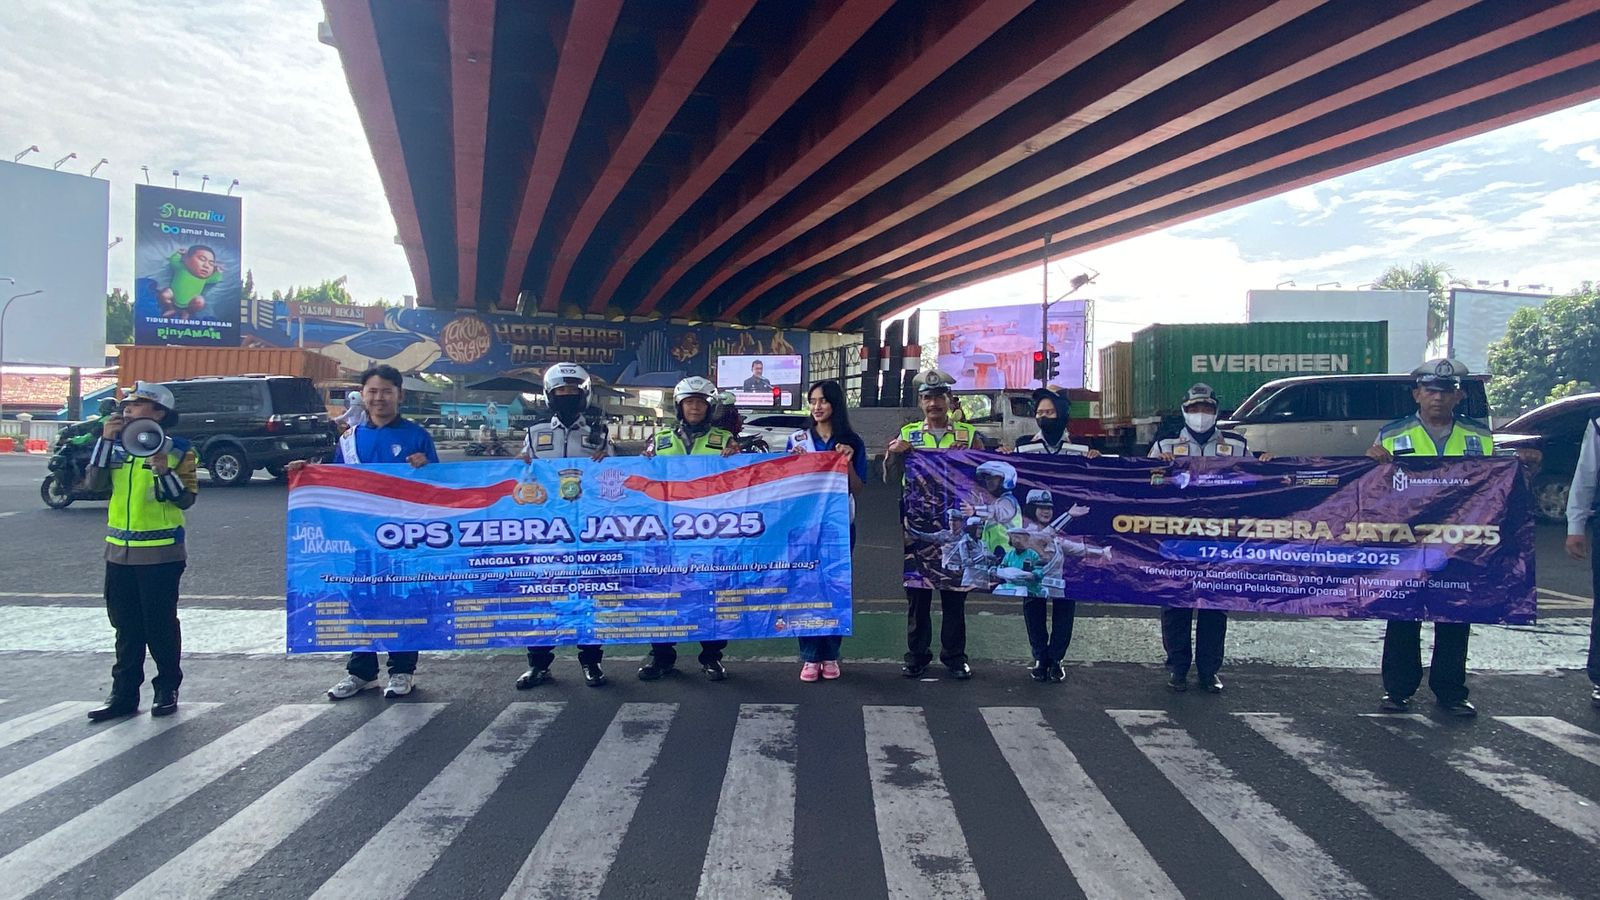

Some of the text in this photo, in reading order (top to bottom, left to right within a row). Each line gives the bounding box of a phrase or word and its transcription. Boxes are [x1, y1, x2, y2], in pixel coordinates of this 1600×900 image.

[177, 207, 225, 222] tunaiku
[181, 228, 203, 236] amar
[204, 229, 226, 238] bank
[299, 304, 364, 319] STASIUN BEKASI
[145, 316, 169, 324] TIDUR
[202, 319, 232, 327] DENGAN
[1191, 353, 1348, 373] EVERGREEN
[292, 526, 324, 540] JAGA
[376, 512, 763, 547] OPS ZEBRA JAYA 2025
[1112, 514, 1501, 546] OPERASI ZEBRA JAYA 2025
[469, 557, 516, 567] TANGGAL
[519, 556, 529, 565] 17
[533, 555, 554, 564] NOV
[563, 554, 574, 563] 30
[577, 554, 597, 563] NOV
[600, 553, 623, 562] 2025
[1199, 546, 1400, 565] 17 s.d 30 November 2025
[481, 571, 505, 581] yang
[506, 569, 538, 579] Aman,
[542, 567, 580, 580] Nyaman
[581, 566, 599, 576] dan
[600, 565, 639, 576] Selamat
[640, 563, 688, 575] Menjelang
[690, 562, 748, 573] Pelaksanaan
[750, 561, 767, 572] Ops
[769, 560, 791, 570] Lilin
[519, 583, 566, 595] TARGET
[1192, 581, 1243, 593] Menjelang
[1244, 583, 1306, 595] Pelaksanaan
[1308, 586, 1347, 598] Operasi
[1298, 574, 1323, 585] yang
[1325, 575, 1357, 586] Aman,
[1359, 576, 1403, 588] Nyaman
[1405, 578, 1425, 588] dan
[1427, 579, 1470, 590] Selamat
